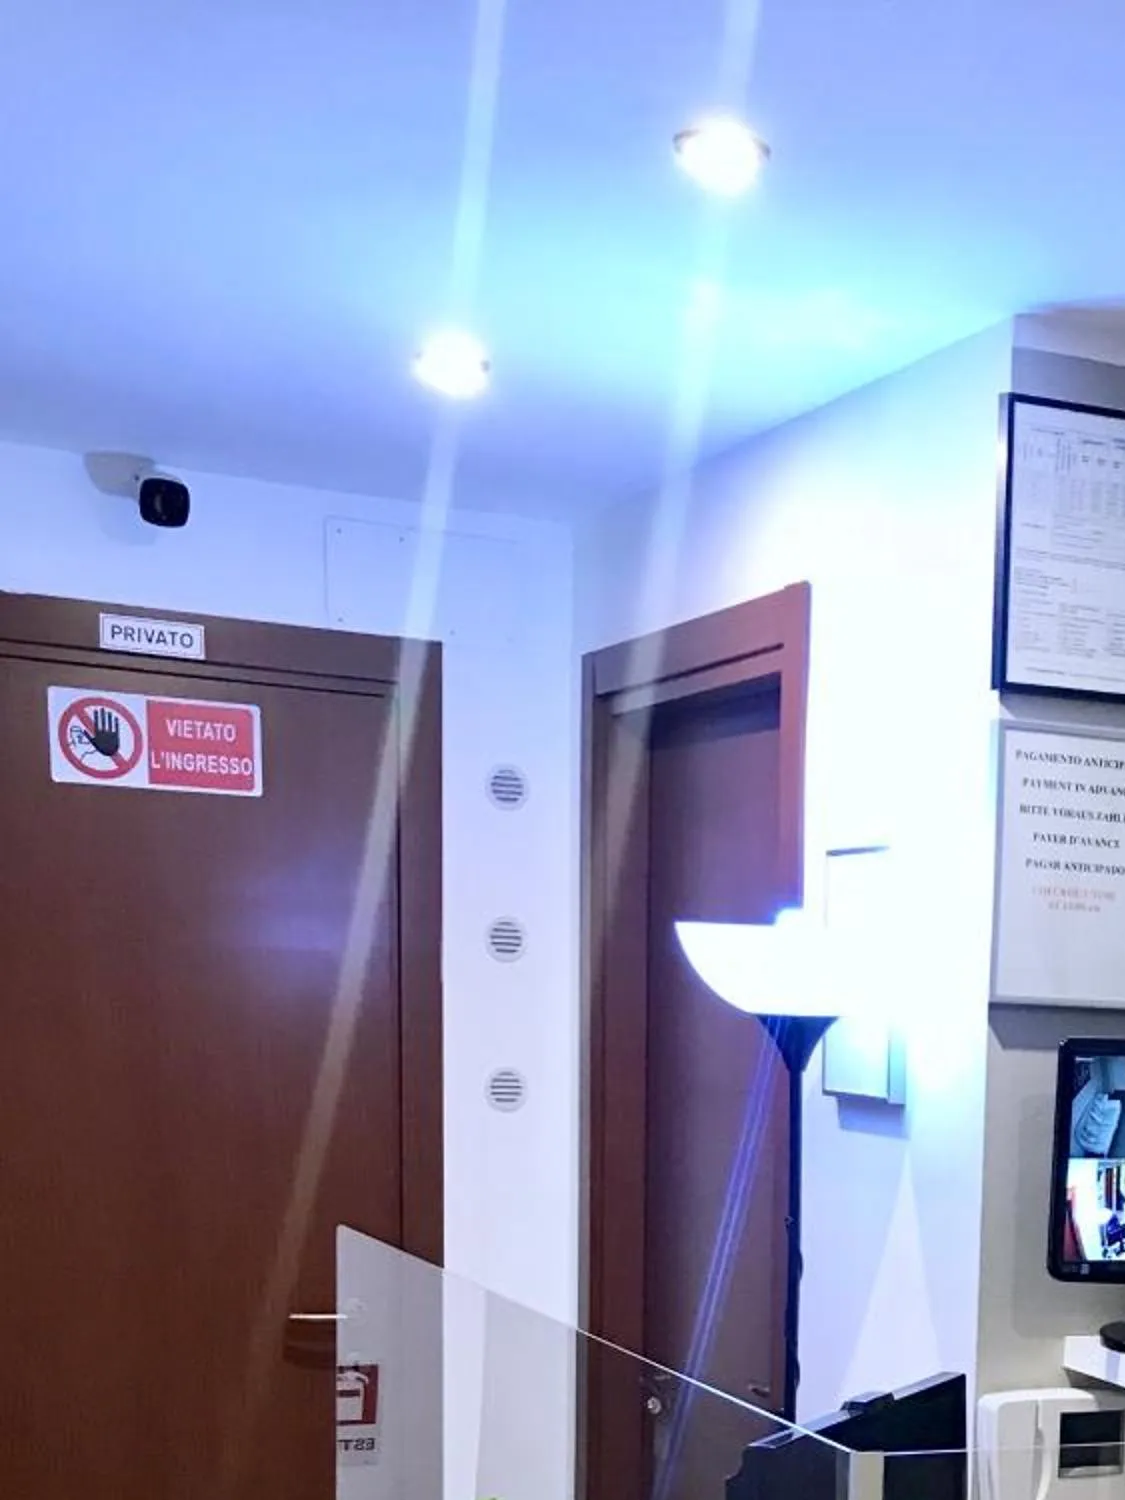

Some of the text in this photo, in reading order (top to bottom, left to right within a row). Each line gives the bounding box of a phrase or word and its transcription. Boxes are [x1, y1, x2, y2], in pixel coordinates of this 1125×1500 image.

[110, 623, 195, 649] PRIVATO
[165, 719, 237, 743] VIETATO
[150, 750, 253, 776] L'INGRESSO
[1015, 749, 1082, 766] PAGAMENTO
[1022, 777, 1072, 790] PAYMENT
[1075, 782, 1085, 792] IN
[1025, 858, 1061, 870] PAGAR
